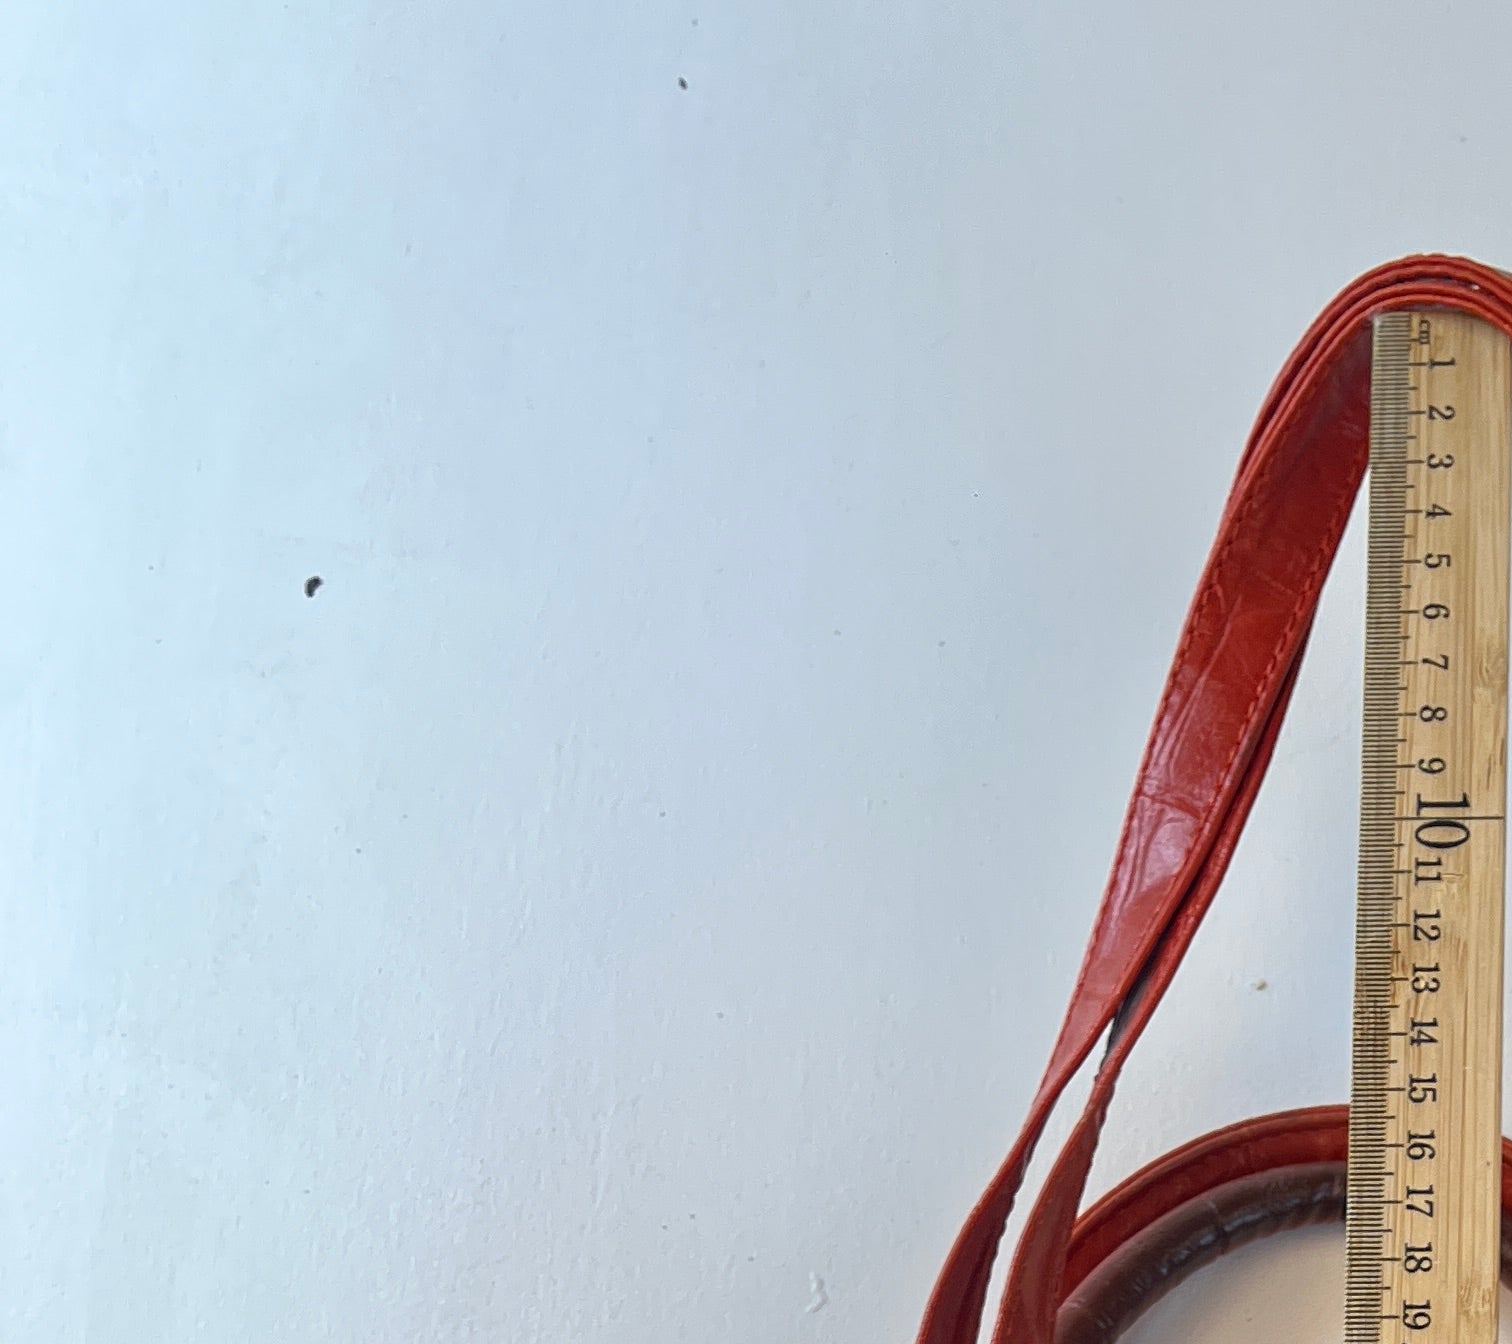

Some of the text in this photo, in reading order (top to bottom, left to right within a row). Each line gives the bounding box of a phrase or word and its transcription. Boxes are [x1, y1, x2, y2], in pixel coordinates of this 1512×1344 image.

[1419, 320, 1430, 344] cm
[1430, 357, 1455, 370] 1
[1428, 406, 1455, 421] 2
[1427, 454, 1454, 469] 3
[1425, 504, 1453, 521] 4
[1424, 553, 1451, 568] 5
[1423, 603, 1450, 619] 6
[1422, 655, 1449, 671] 7
[1420, 706, 1447, 722] 8
[1418, 757, 1445, 774] 9
[1415, 794, 1470, 849] 10
[1414, 856, 1442, 885] 11
[1413, 910, 1441, 942] 12
[1411, 963, 1440, 993] 13
[1410, 1018, 1438, 1046] 14
[1408, 1074, 1436, 1103] 15
[1406, 1130, 1436, 1161] 16
[1405, 1186, 1434, 1218] 17
[1403, 1243, 1432, 1274] 18
[1402, 1300, 1431, 1330] 19
